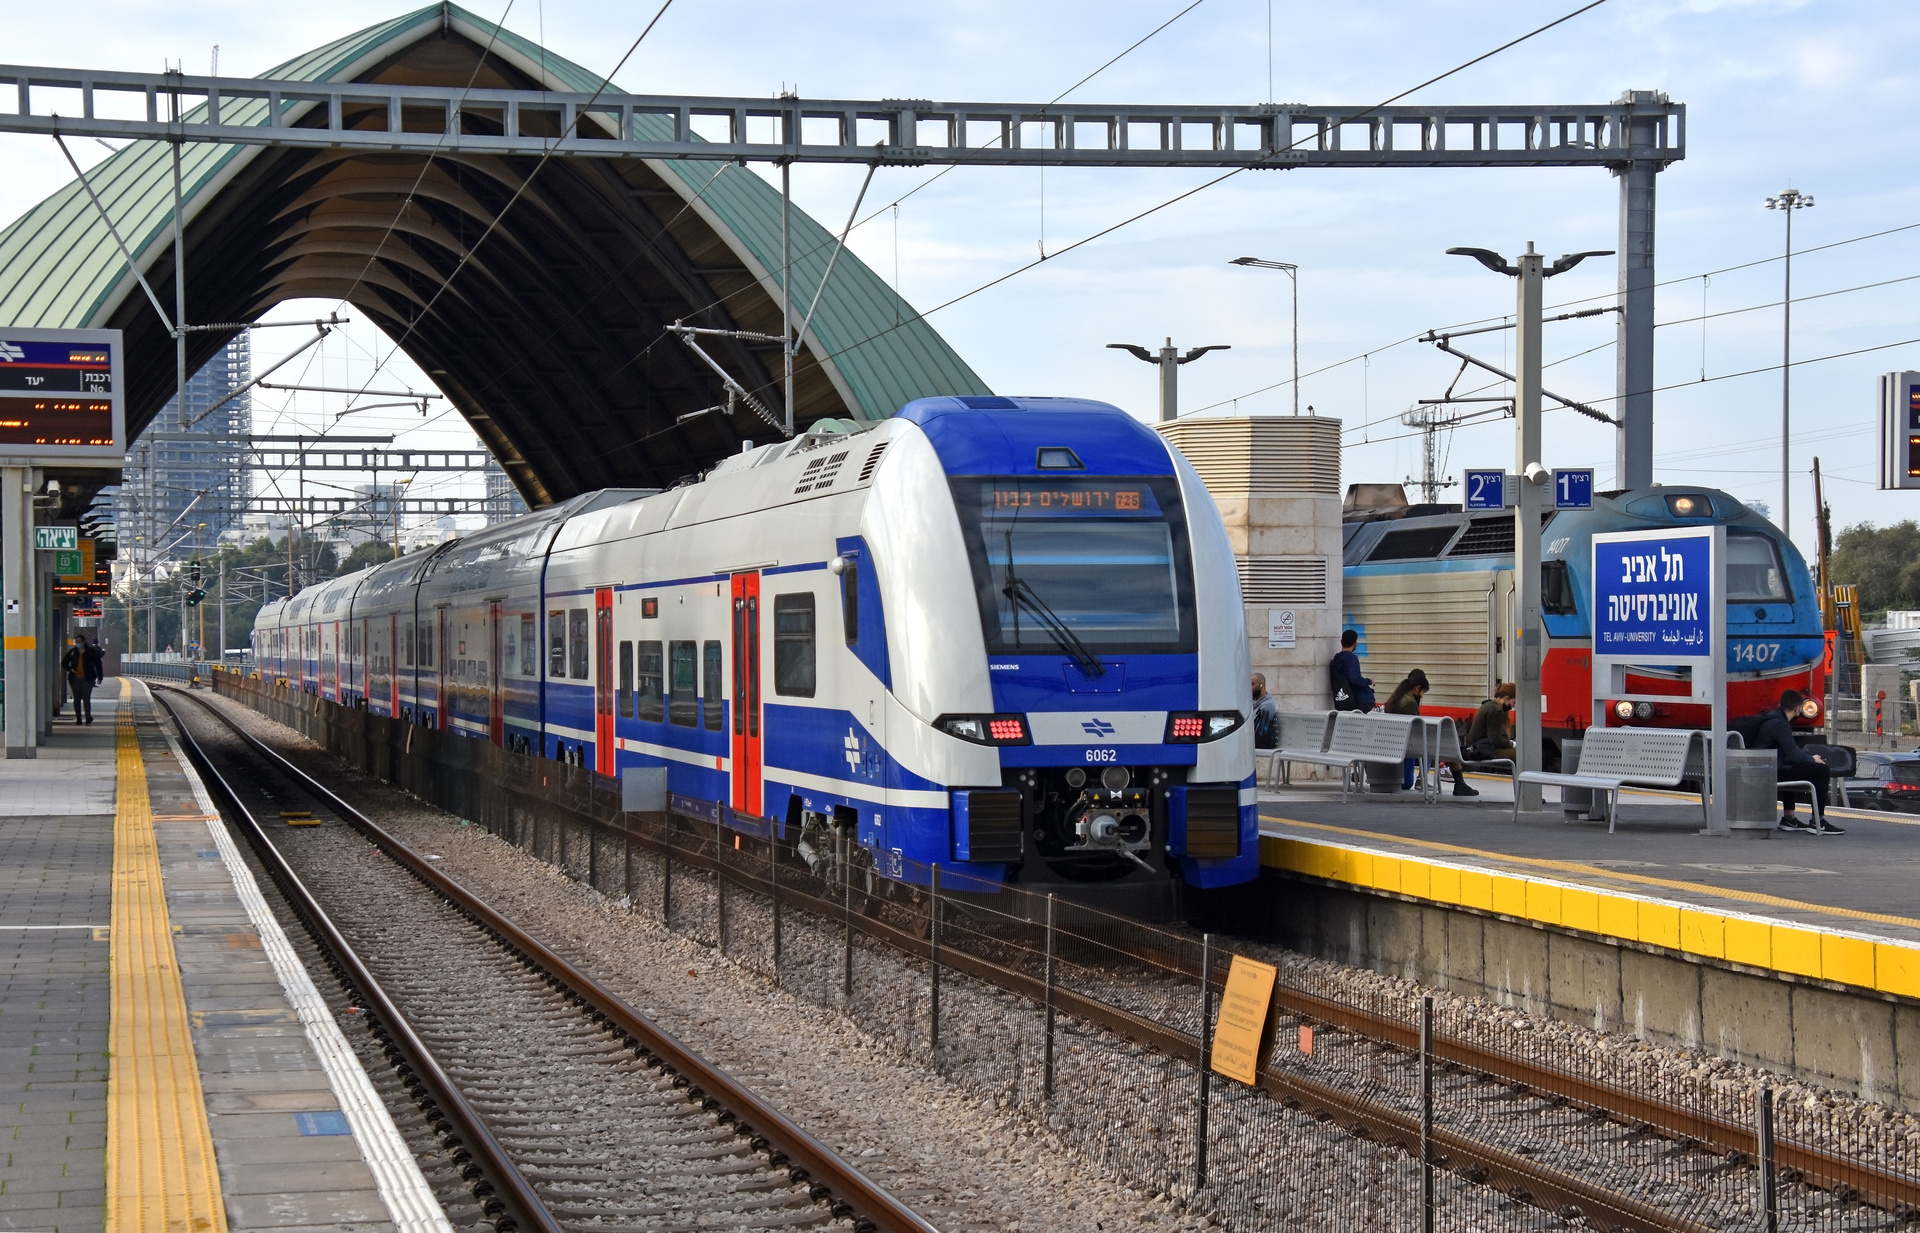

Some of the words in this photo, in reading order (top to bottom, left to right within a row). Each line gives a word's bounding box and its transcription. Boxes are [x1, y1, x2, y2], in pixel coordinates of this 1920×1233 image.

[25, 376, 44, 386] יעד
[85, 373, 111, 382] רכבת
[90, 384, 107, 393] No.
[1484, 475, 1501, 484] רציף
[1572, 474, 1589, 483] רציף
[1470, 474, 1485, 501] 2
[1558, 474, 1569, 500] 1
[1040, 491, 1110, 506] ירושלים
[40, 528, 75, 548] יציאה
[1621, 554, 1658, 583] אביב
[1661, 546, 1684, 582] תל
[1608, 592, 1698, 622] אוניברסיטה
[1603, 631, 1613, 642] TEL
[1732, 643, 1780, 663] 1407
[1085, 749, 1117, 762] 6062
